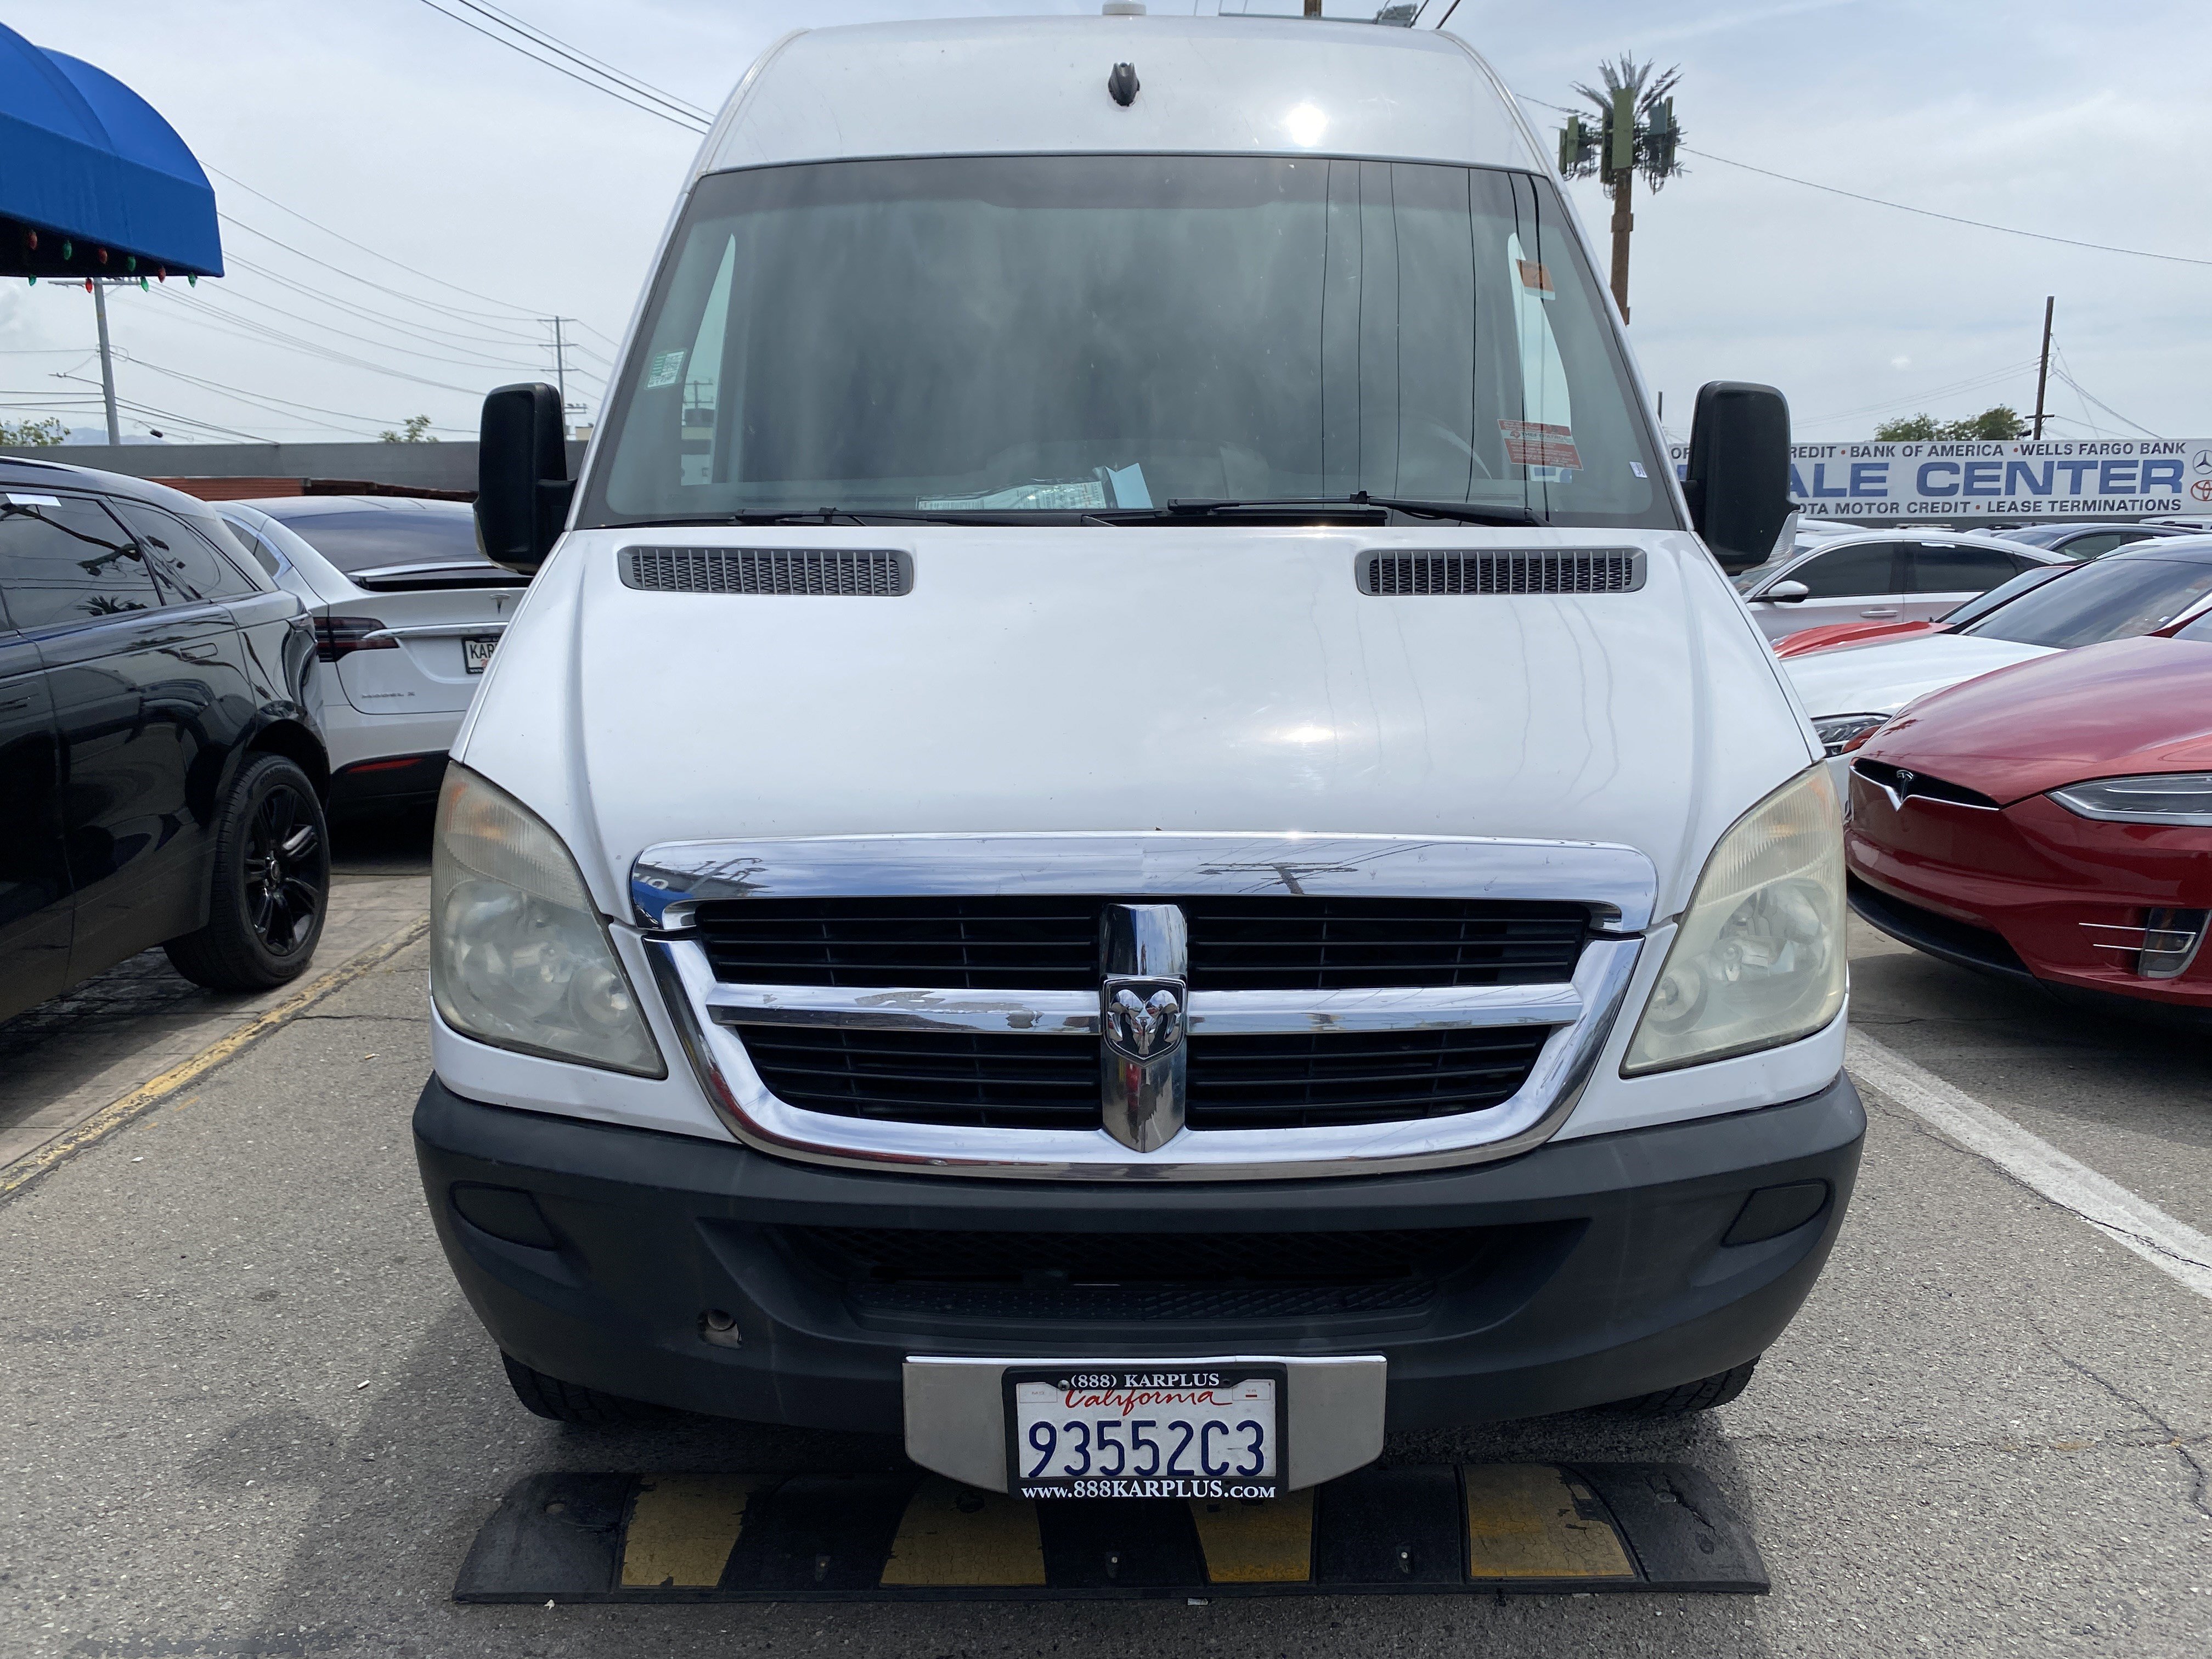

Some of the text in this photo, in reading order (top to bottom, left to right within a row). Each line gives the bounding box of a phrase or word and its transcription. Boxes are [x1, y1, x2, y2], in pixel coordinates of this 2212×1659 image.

[1790, 442, 2186, 458] REDIT BANK OF AMERICA WELLS FARGO BANK
[1789, 459, 2185, 498] ALE CENTER
[1835, 501, 1900, 515] MOTOR
[1906, 501, 1971, 514] CREDIT
[1987, 500, 2042, 513] LEASE
[2048, 499, 2181, 512] TERMINATIONS
[1071, 1373, 1220, 1387] (888) KARPLUS
[1065, 1389, 1233, 1417] California
[1028, 1420, 1265, 1477] 93552C3
